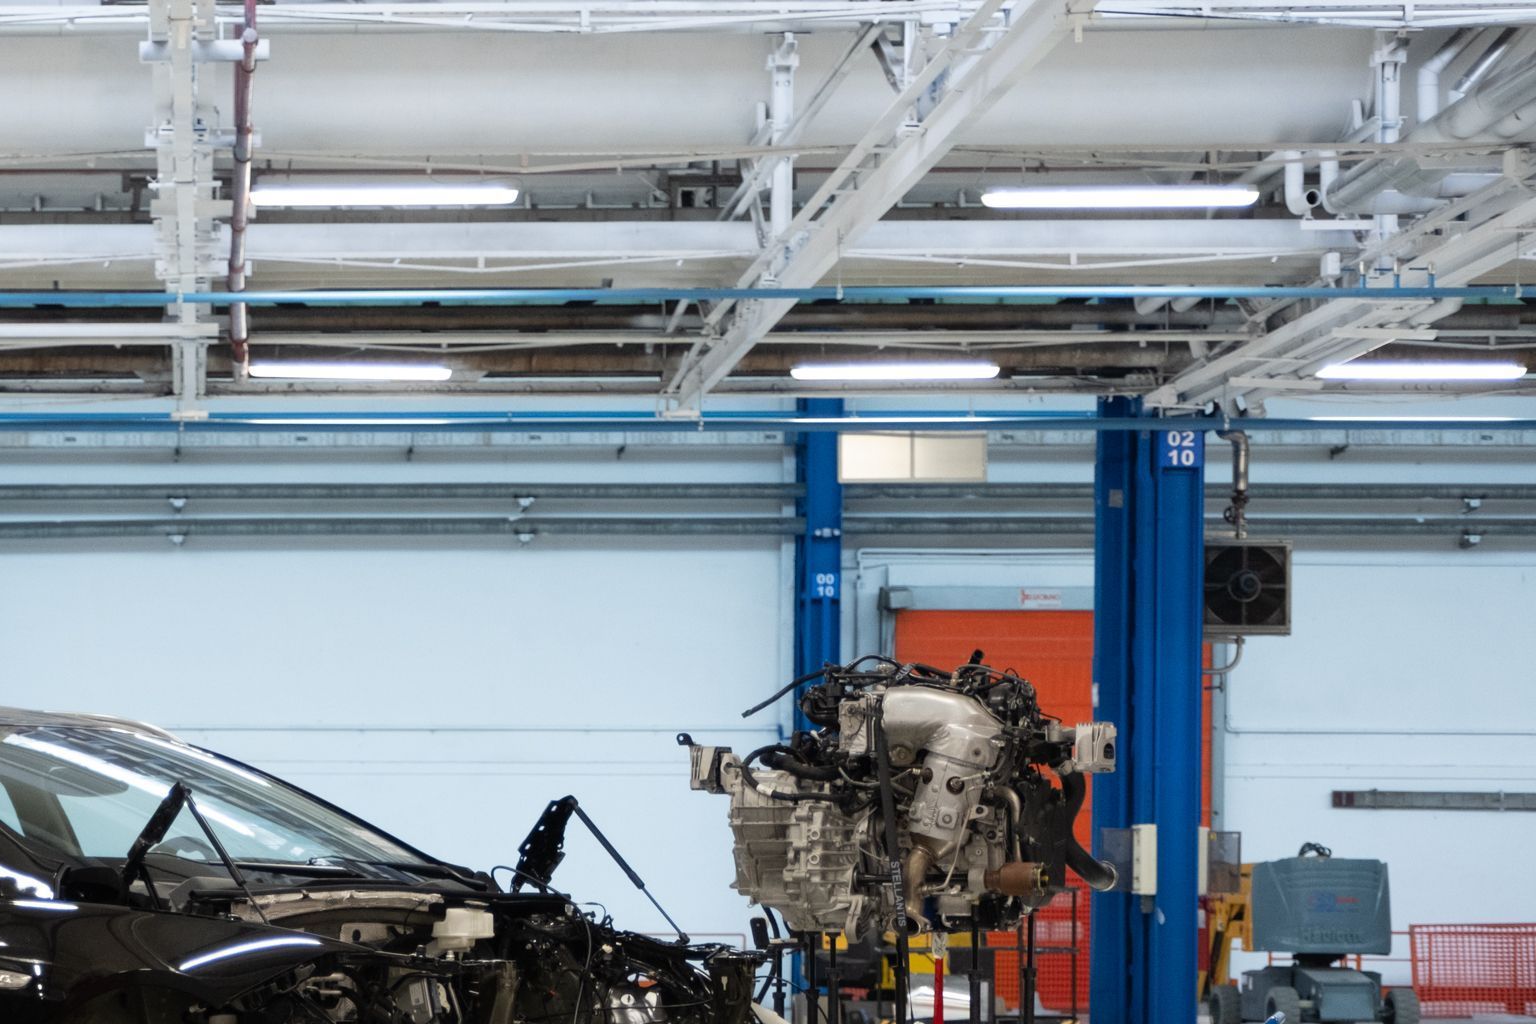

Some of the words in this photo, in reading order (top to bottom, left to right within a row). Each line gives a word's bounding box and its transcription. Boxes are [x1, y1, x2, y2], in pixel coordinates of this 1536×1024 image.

[1168, 431, 1194, 447] 02
[1168, 450, 1194, 465] 10
[816, 573, 834, 585] 00
[817, 586, 834, 597] 10
[891, 861, 907, 927] STELLANTIS
